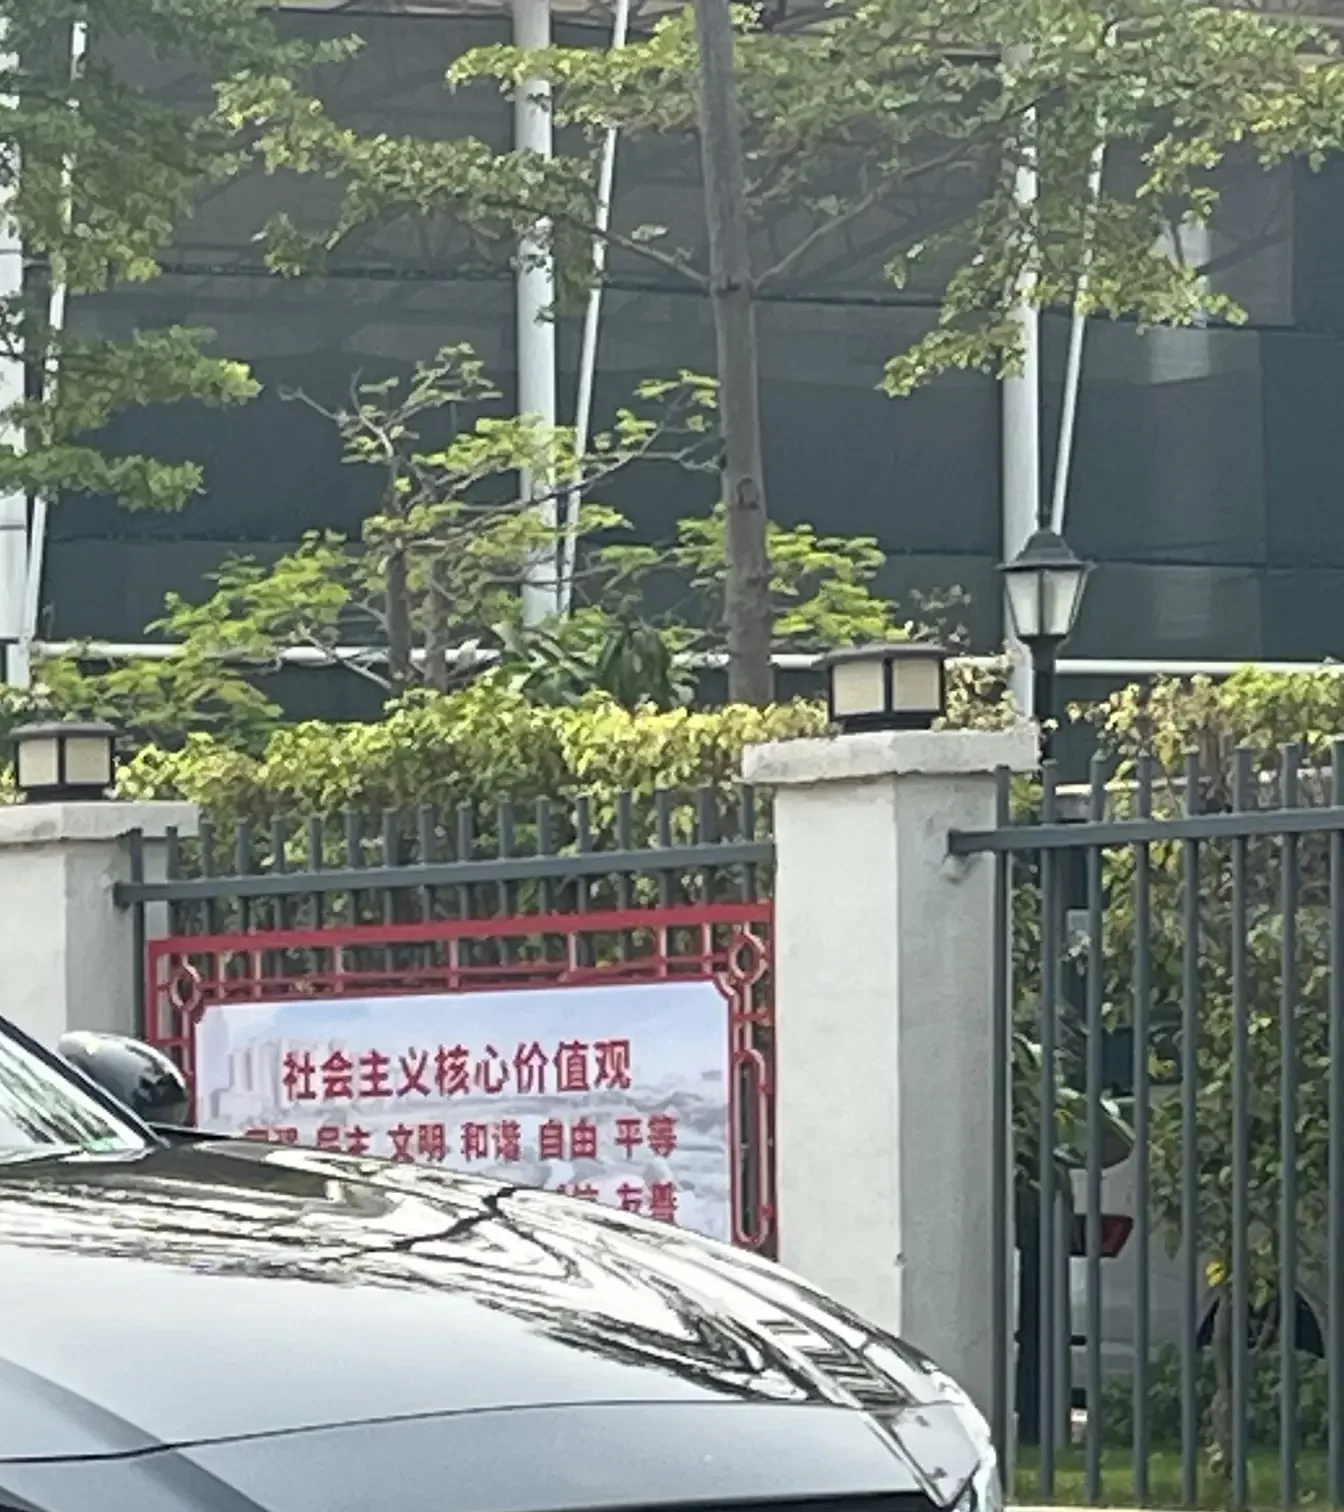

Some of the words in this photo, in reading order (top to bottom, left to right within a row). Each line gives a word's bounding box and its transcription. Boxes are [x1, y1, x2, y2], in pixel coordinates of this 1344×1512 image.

[282, 1039, 631, 1102] 社会主义核心价值观
[387, 1121, 447, 1163] 文明
[461, 1119, 521, 1162] 和谐
[539, 1116, 597, 1160] 自由
[615, 1112, 677, 1159] 平等
